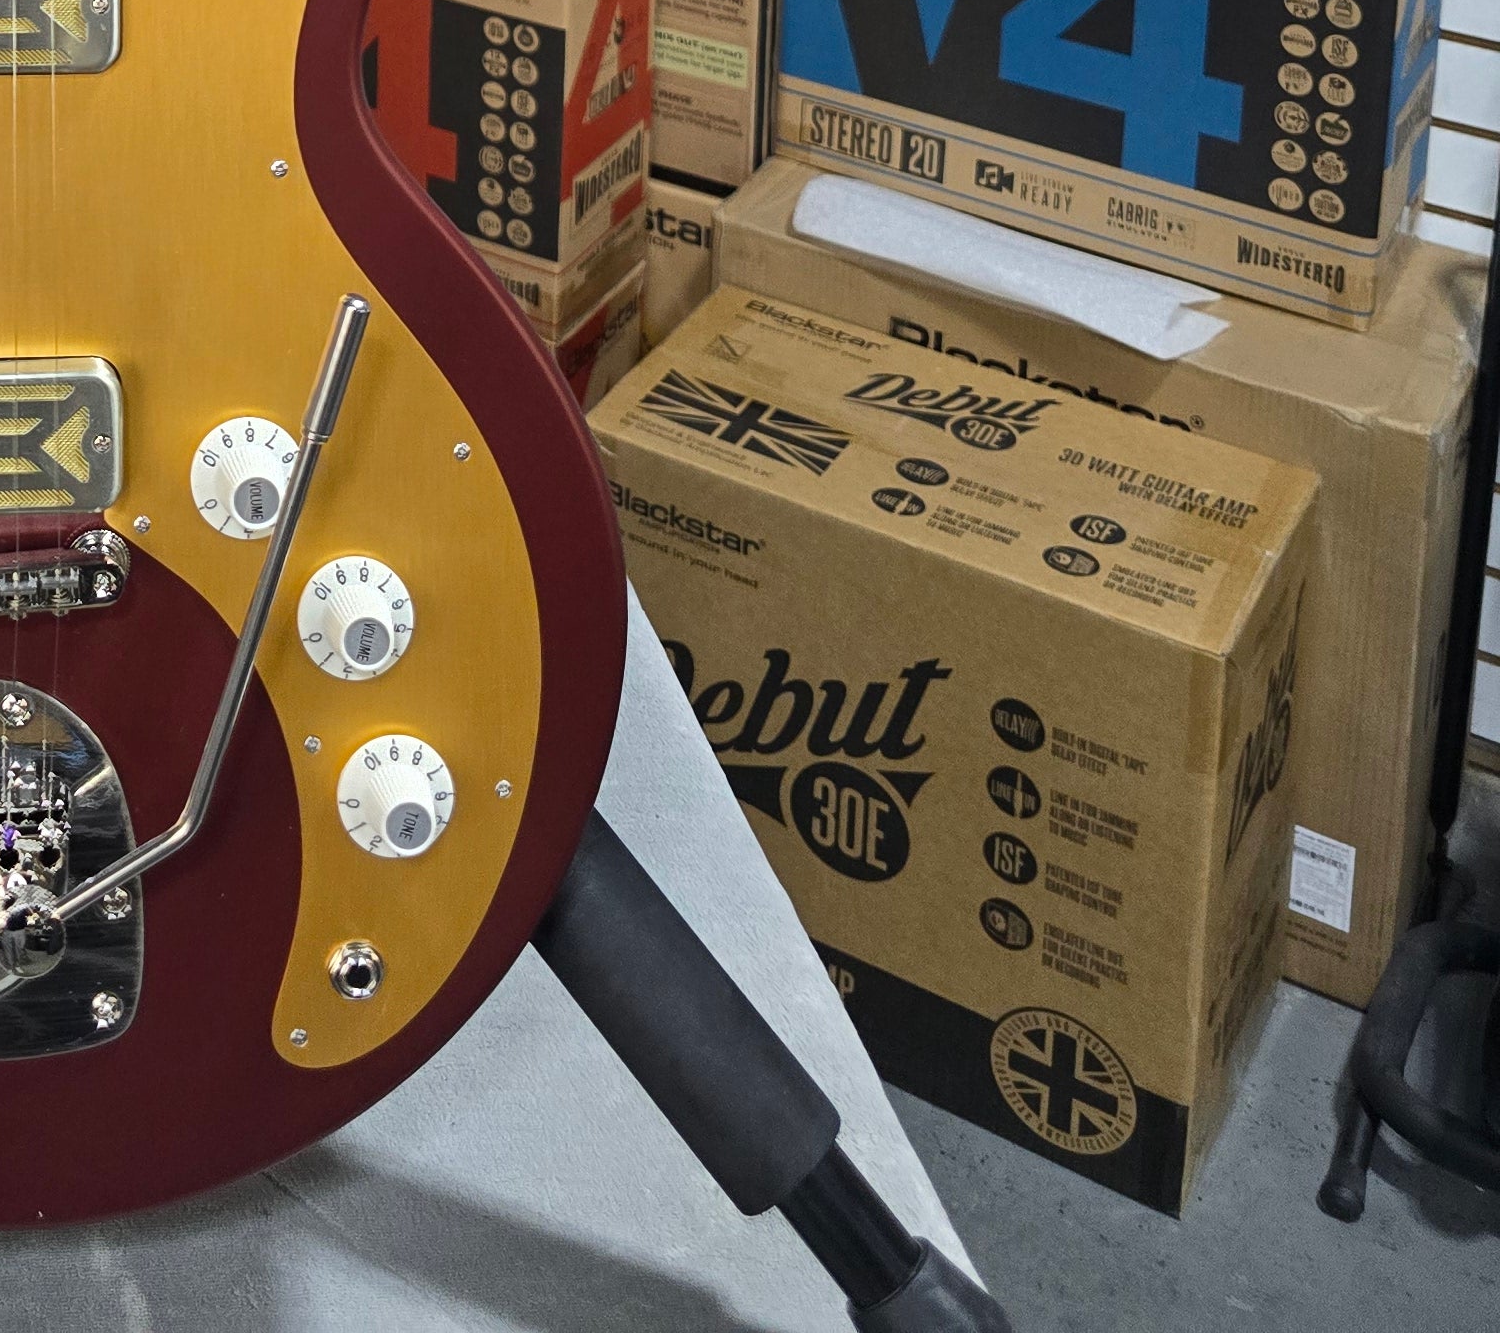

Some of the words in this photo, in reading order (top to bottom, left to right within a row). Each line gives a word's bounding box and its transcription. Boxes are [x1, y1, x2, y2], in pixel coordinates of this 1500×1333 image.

[809, 105, 893, 165] STEREO
[908, 134, 940, 179] 20
[1019, 182, 1073, 214] READY
[1106, 196, 1159, 231] CABRIG
[1236, 234, 1346, 294] WIDESTEREO
[745, 298, 886, 352] Blackstar
[843, 371, 1062, 422] Debut
[221, 434, 233, 449] 9
[245, 427, 255, 443] 8
[265, 434, 276, 450] 7
[959, 418, 1010, 450] 30E
[202, 449, 220, 468] 10
[281, 452, 295, 464] 6
[1058, 447, 1084, 467] 30
[1088, 455, 1141, 485] WATT
[1142, 472, 1210, 506] GUITAR
[1211, 494, 1260, 519] AMP
[204, 499, 218, 509] 0
[249, 480, 264, 521] VOLUME
[1118, 481, 1153, 502] WITH
[1154, 491, 1197, 516] DELAY
[1197, 506, 1249, 531] EFFECT
[609, 480, 761, 556] Blackstar
[1077, 517, 1119, 542] ISF
[627, 533, 669, 555] sound
[672, 546, 686, 561] in
[687, 557, 721, 573] your
[723, 565, 759, 589] head
[335, 569, 347, 585] 9
[360, 567, 369, 583] 8
[314, 582, 332, 601] 10
[377, 577, 390, 593] 7
[391, 598, 405, 610] 6
[308, 632, 323, 643] 0
[356, 623, 377, 662] VOLUME
[994, 708, 1026, 733] DELAY
[364, 752, 382, 771] 10
[389, 745, 400, 762] 9
[412, 751, 423, 766] 8
[426, 768, 440, 782] 7
[346, 798, 360, 809] 0
[434, 791, 448, 801] 6
[398, 811, 420, 842] TONE
[811, 775, 890, 873] 30E
[369, 834, 383, 849] 2
[992, 836, 1027, 879] ISF
